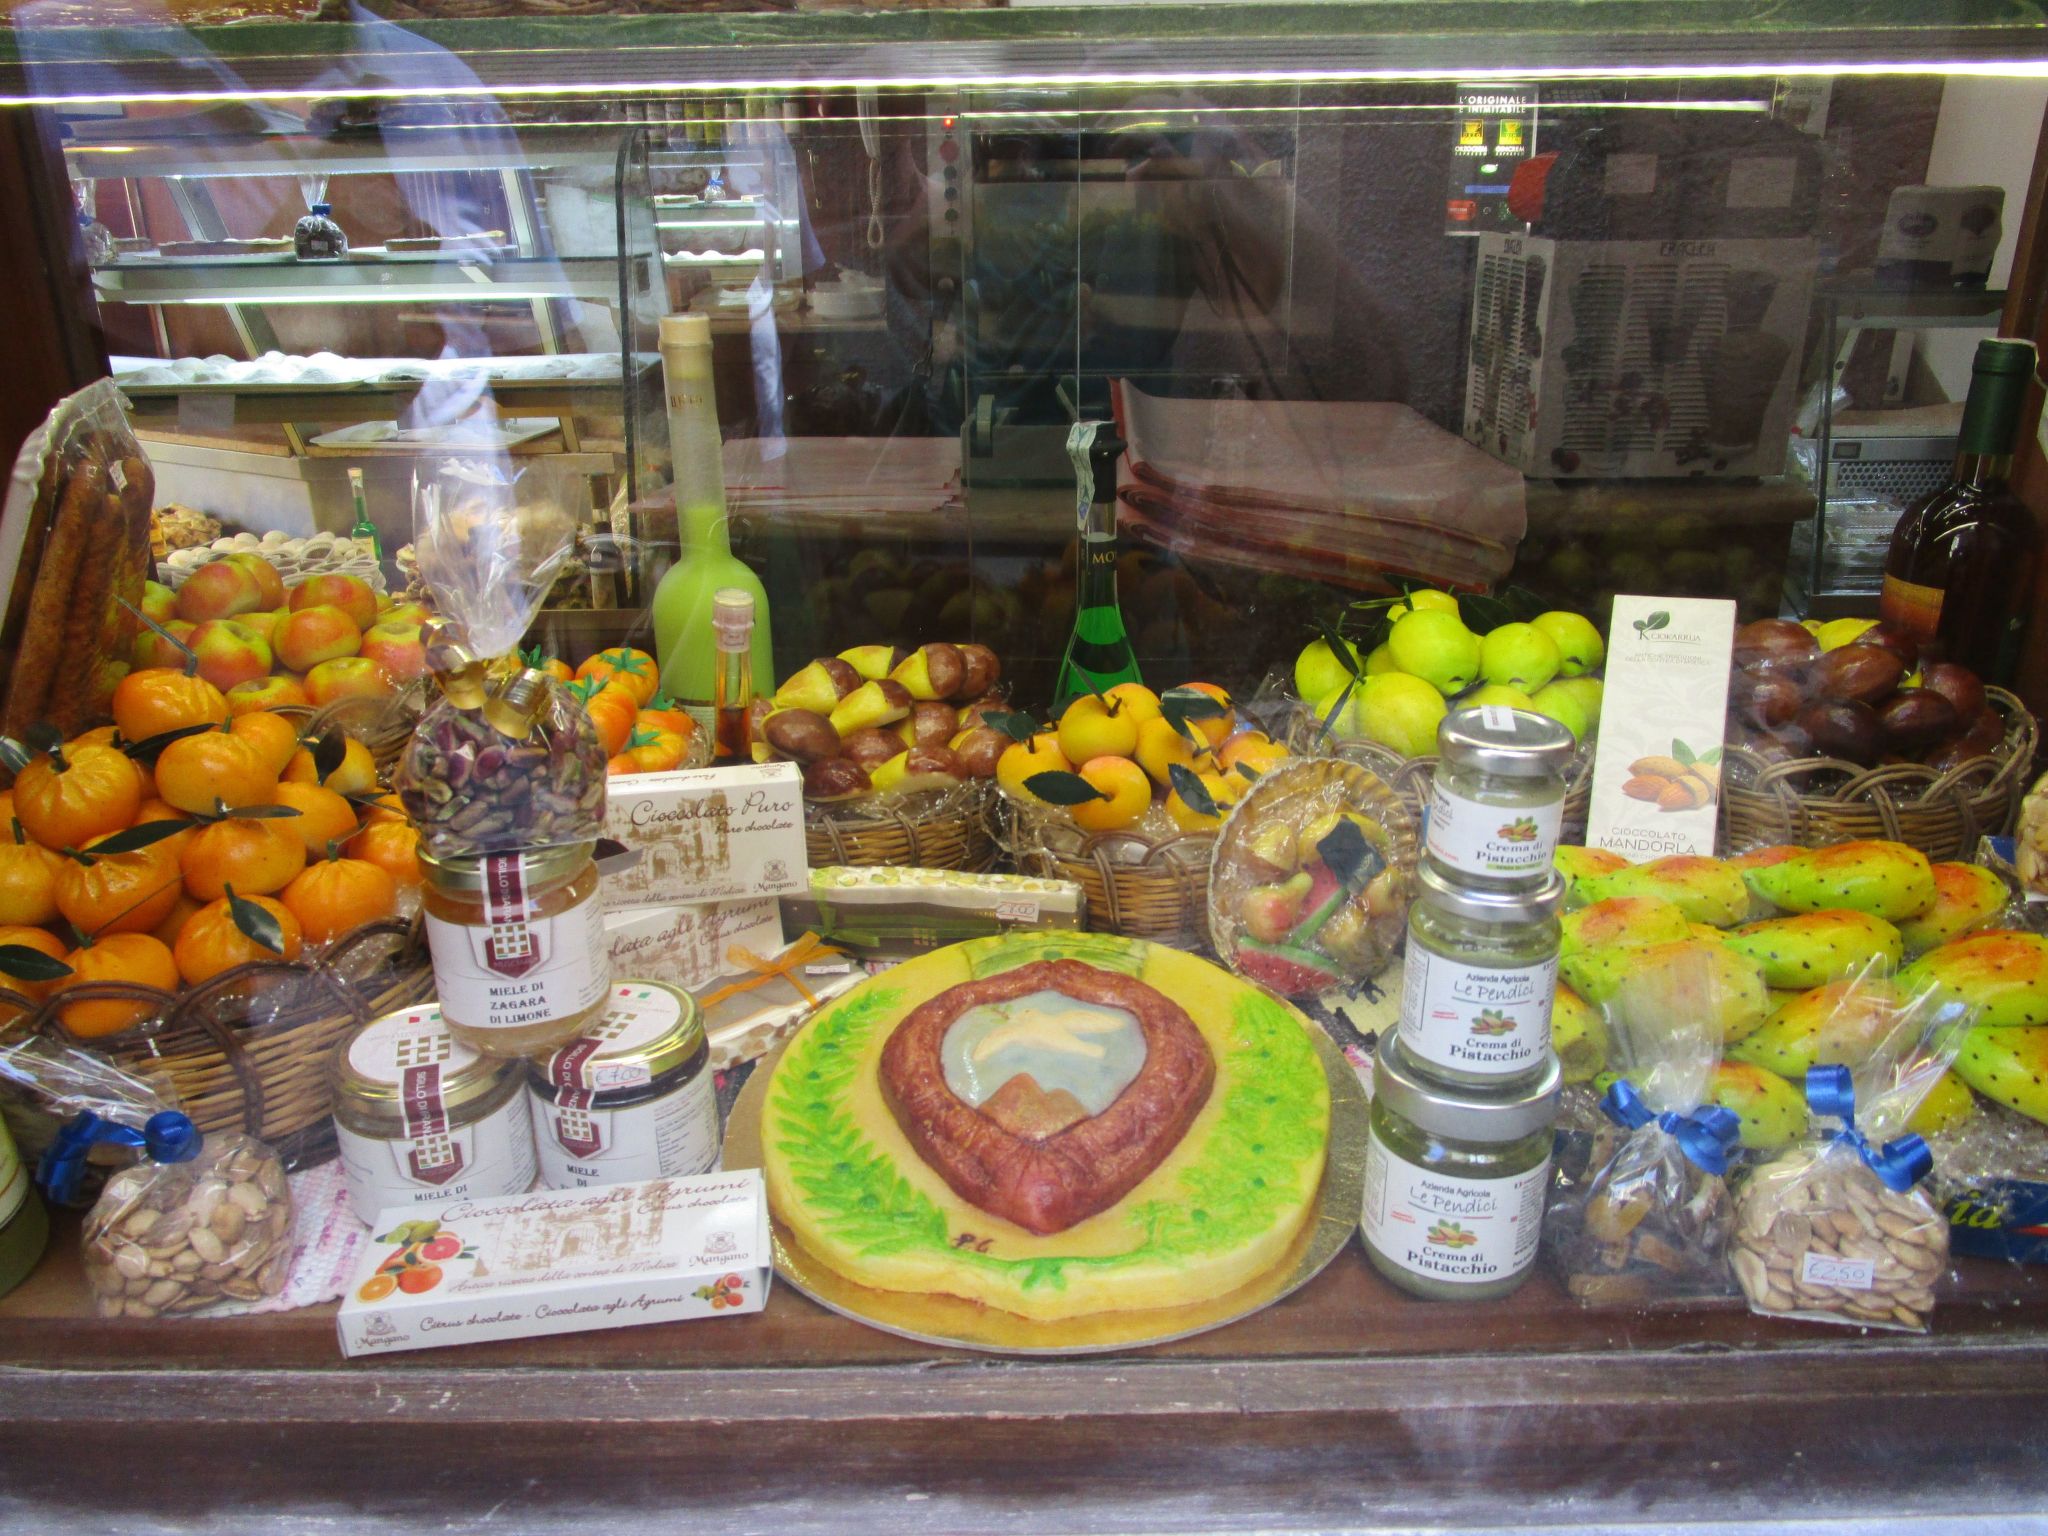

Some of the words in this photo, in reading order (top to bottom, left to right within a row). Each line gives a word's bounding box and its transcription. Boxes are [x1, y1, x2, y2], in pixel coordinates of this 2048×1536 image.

[1459, 95, 1526, 105] L'ORIGINALE
[630, 798, 738, 827] Cioccolato
[741, 789, 795, 815] Puro
[714, 821, 744, 835] Pure
[744, 820, 794, 833] chocolate
[1611, 826, 1687, 841] CIOCCOLATO
[1486, 841, 1530, 852] Crema
[1532, 839, 1544, 851] di
[1599, 835, 1697, 856] MANDORLA
[1475, 849, 1547, 865] Pistacchio
[752, 879, 798, 894] Mangano
[1466, 972, 1499, 983] Azienda
[1500, 973, 1531, 985] Agricola
[489, 983, 529, 997] MIELE
[531, 981, 545, 992] DI
[1453, 980, 1472, 995] Le
[1477, 981, 1536, 1001] Pendici
[490, 995, 547, 1011] ZAGARA
[489, 1014, 502, 1025] DI
[505, 1008, 552, 1024] LIMONE
[1466, 1037, 1507, 1049] Crema
[1510, 1037, 1522, 1048] di
[1450, 1044, 1531, 1062] Pistacchio
[566, 1163, 600, 1178] MIELE
[577, 1178, 588, 1188] DI
[638, 1178, 751, 1201] Agrumi
[1420, 1179, 1455, 1195] Azienda
[1456, 1187, 1491, 1198] Agricola
[414, 1188, 448, 1202] MIELE
[456, 1184, 468, 1195] DI
[1409, 1185, 1427, 1204] Le
[1433, 1194, 1499, 1215] Pendici
[688, 1251, 750, 1267] Mangano
[1406, 1249, 1498, 1275] Pistacchio
[1422, 1245, 1470, 1263] Crema
[1471, 1251, 1484, 1263] di
[419, 1316, 463, 1332] Citrus
[354, 1333, 411, 1349] Mangano
